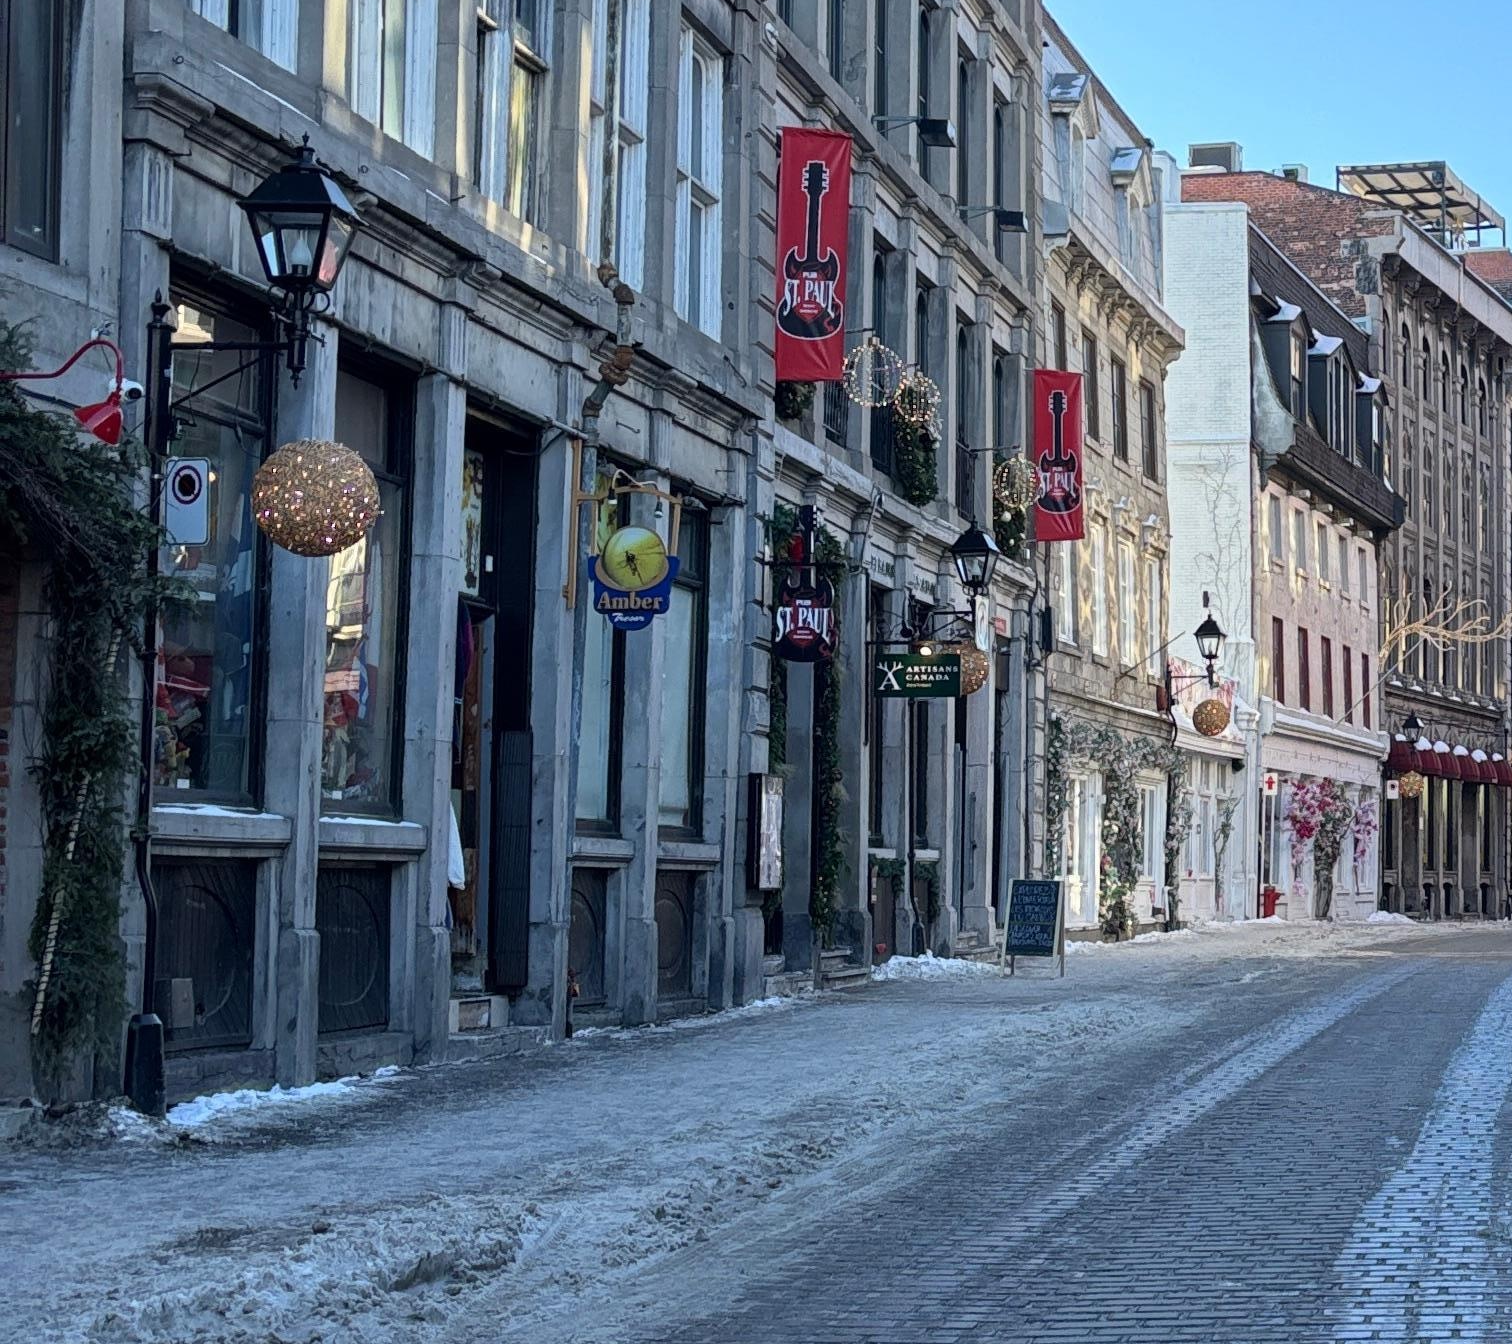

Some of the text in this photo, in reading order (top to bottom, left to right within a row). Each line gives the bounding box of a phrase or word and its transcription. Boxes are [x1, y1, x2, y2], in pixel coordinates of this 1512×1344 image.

[783, 279, 834, 319] ST. PAUL
[597, 591, 663, 610] Amber
[775, 606, 832, 646] ST. PAUL
[906, 665, 959, 673] ARTISANS
